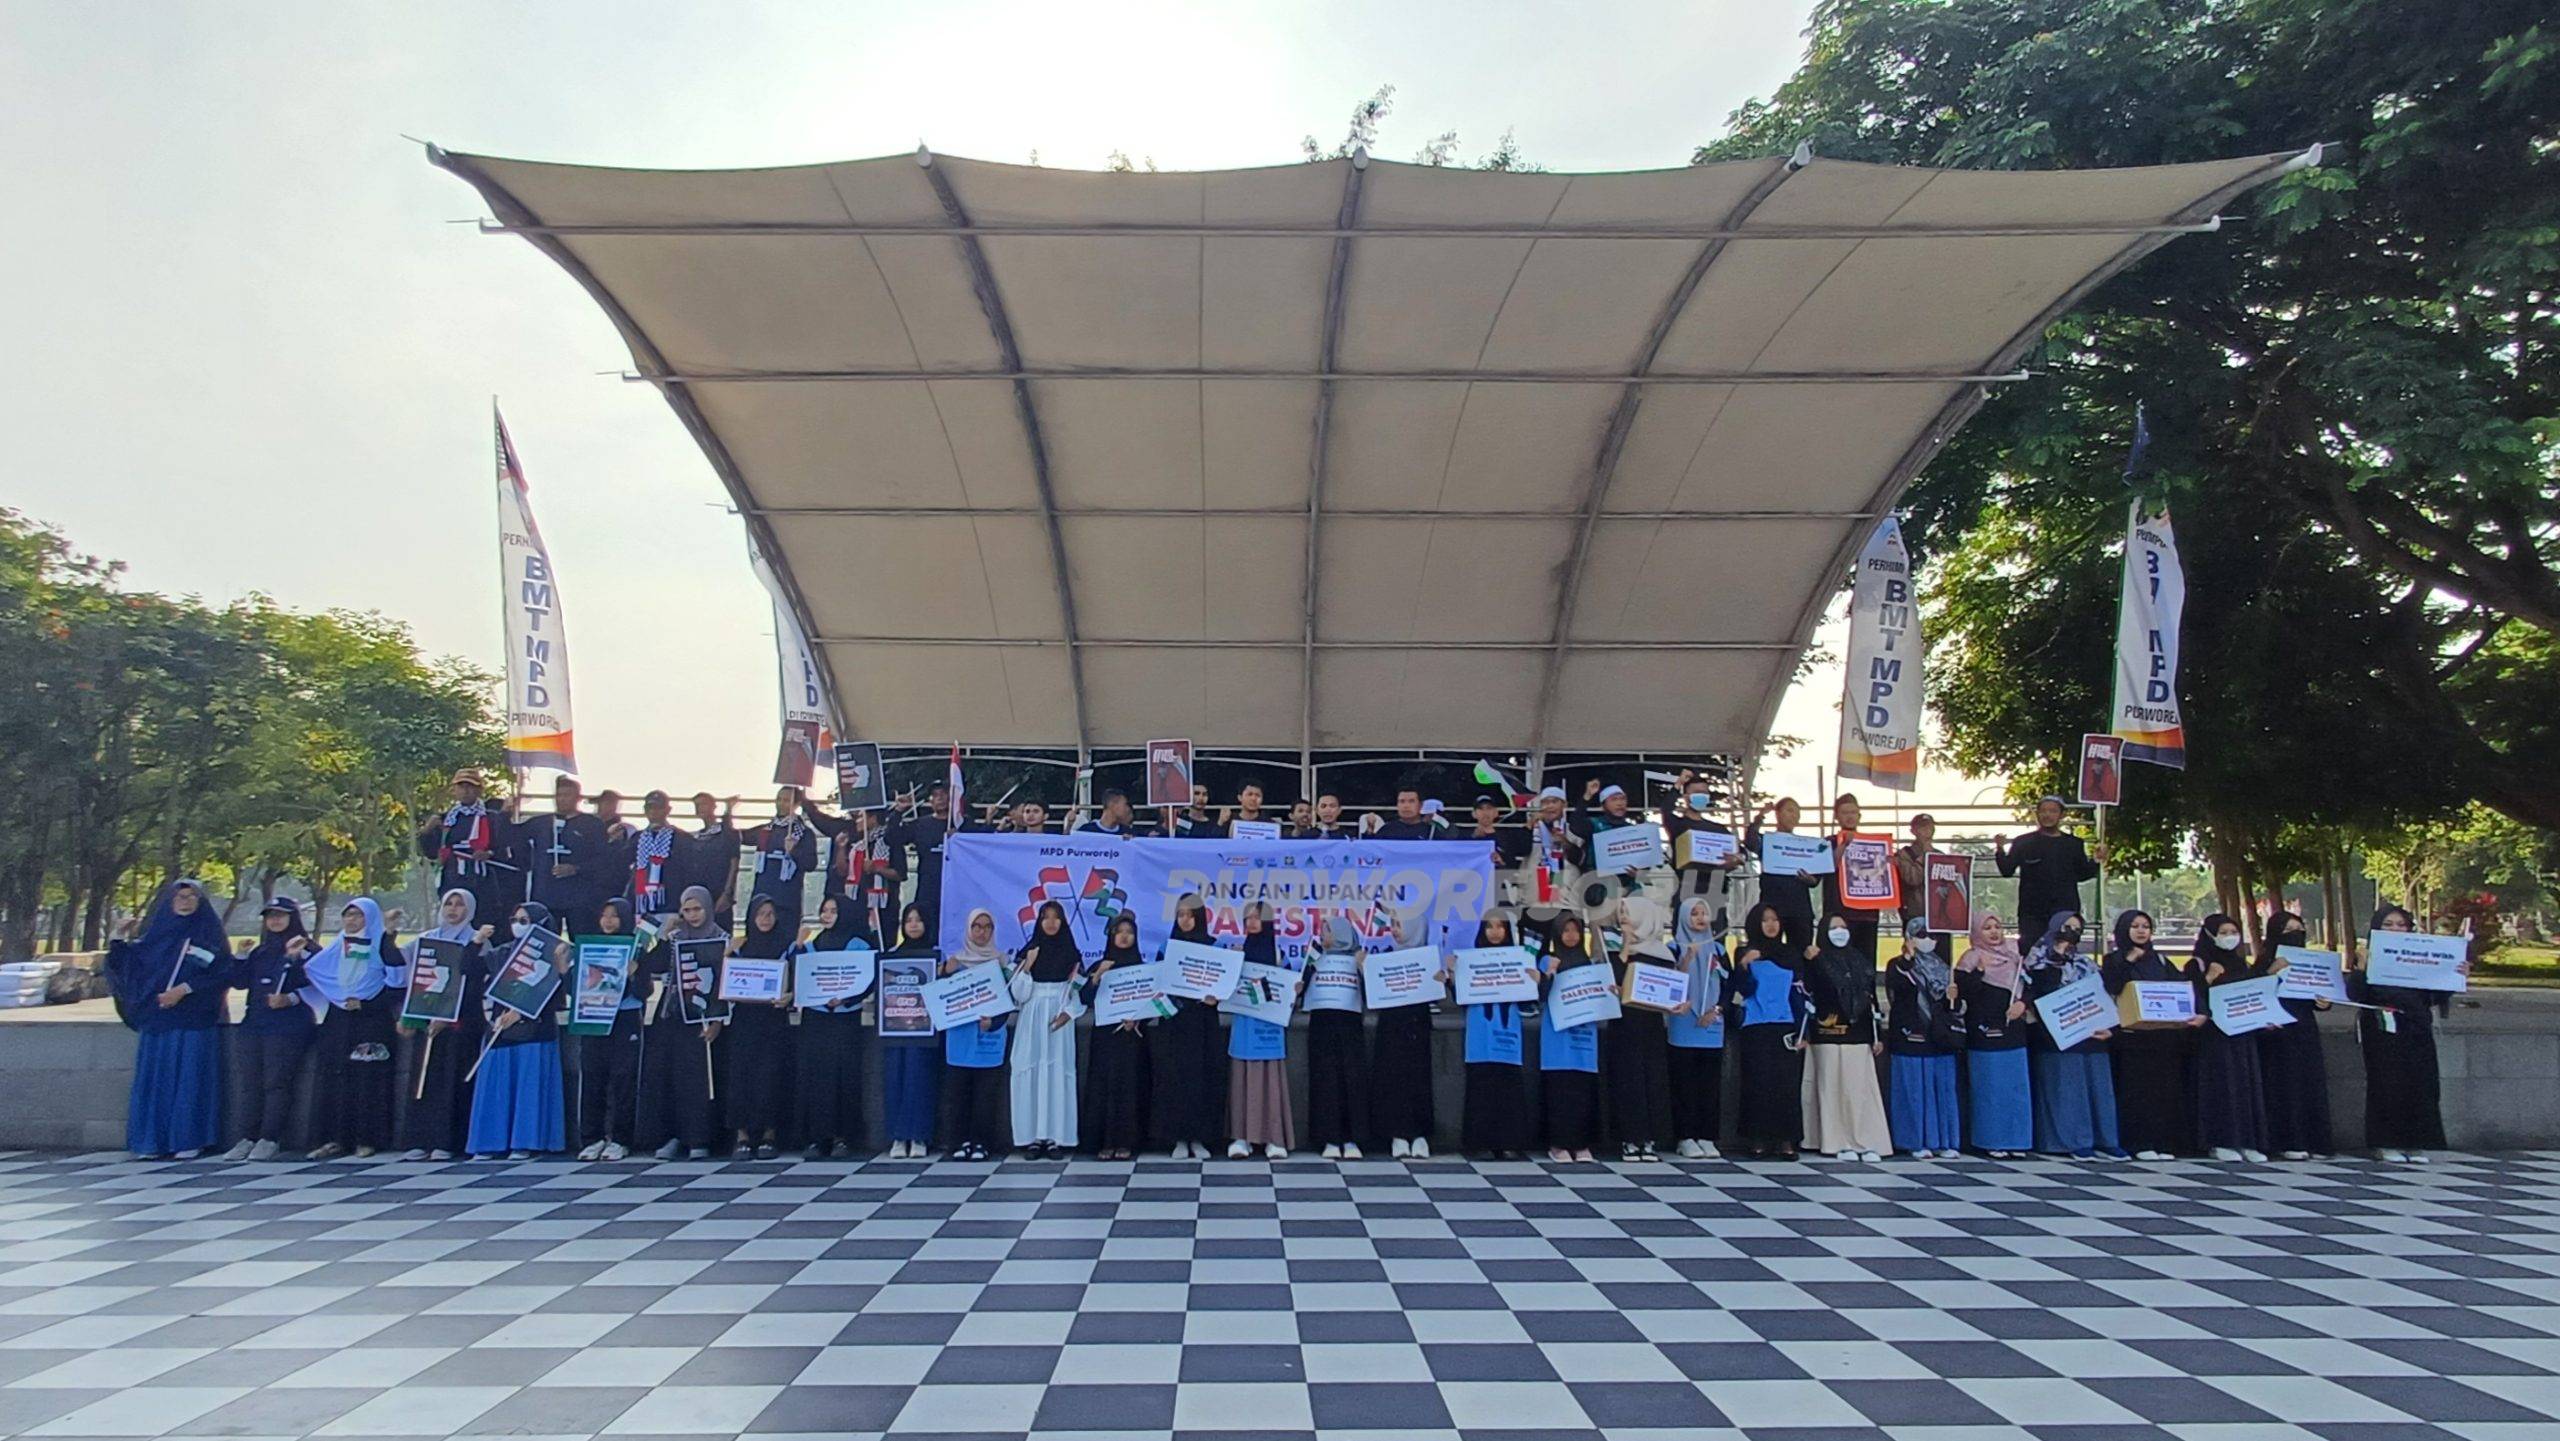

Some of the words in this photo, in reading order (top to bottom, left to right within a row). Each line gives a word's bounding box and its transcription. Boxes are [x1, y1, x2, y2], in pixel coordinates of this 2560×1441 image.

[522, 555, 551, 631] BMT
[1879, 579, 1908, 651] BMT
[526, 634, 551, 708] MPD
[1866, 657, 1901, 728] MPD
[2125, 705, 2178, 725] PURWORE
[1851, 727, 1907, 751] PUWOREJO
[1040, 847, 1064, 857] MPD
[1067, 848, 1120, 859] Purworejo
[1300, 883, 1406, 900] LUPAKAN
[2401, 949, 2429, 957] Stand
[2431, 952, 2455, 960] With
